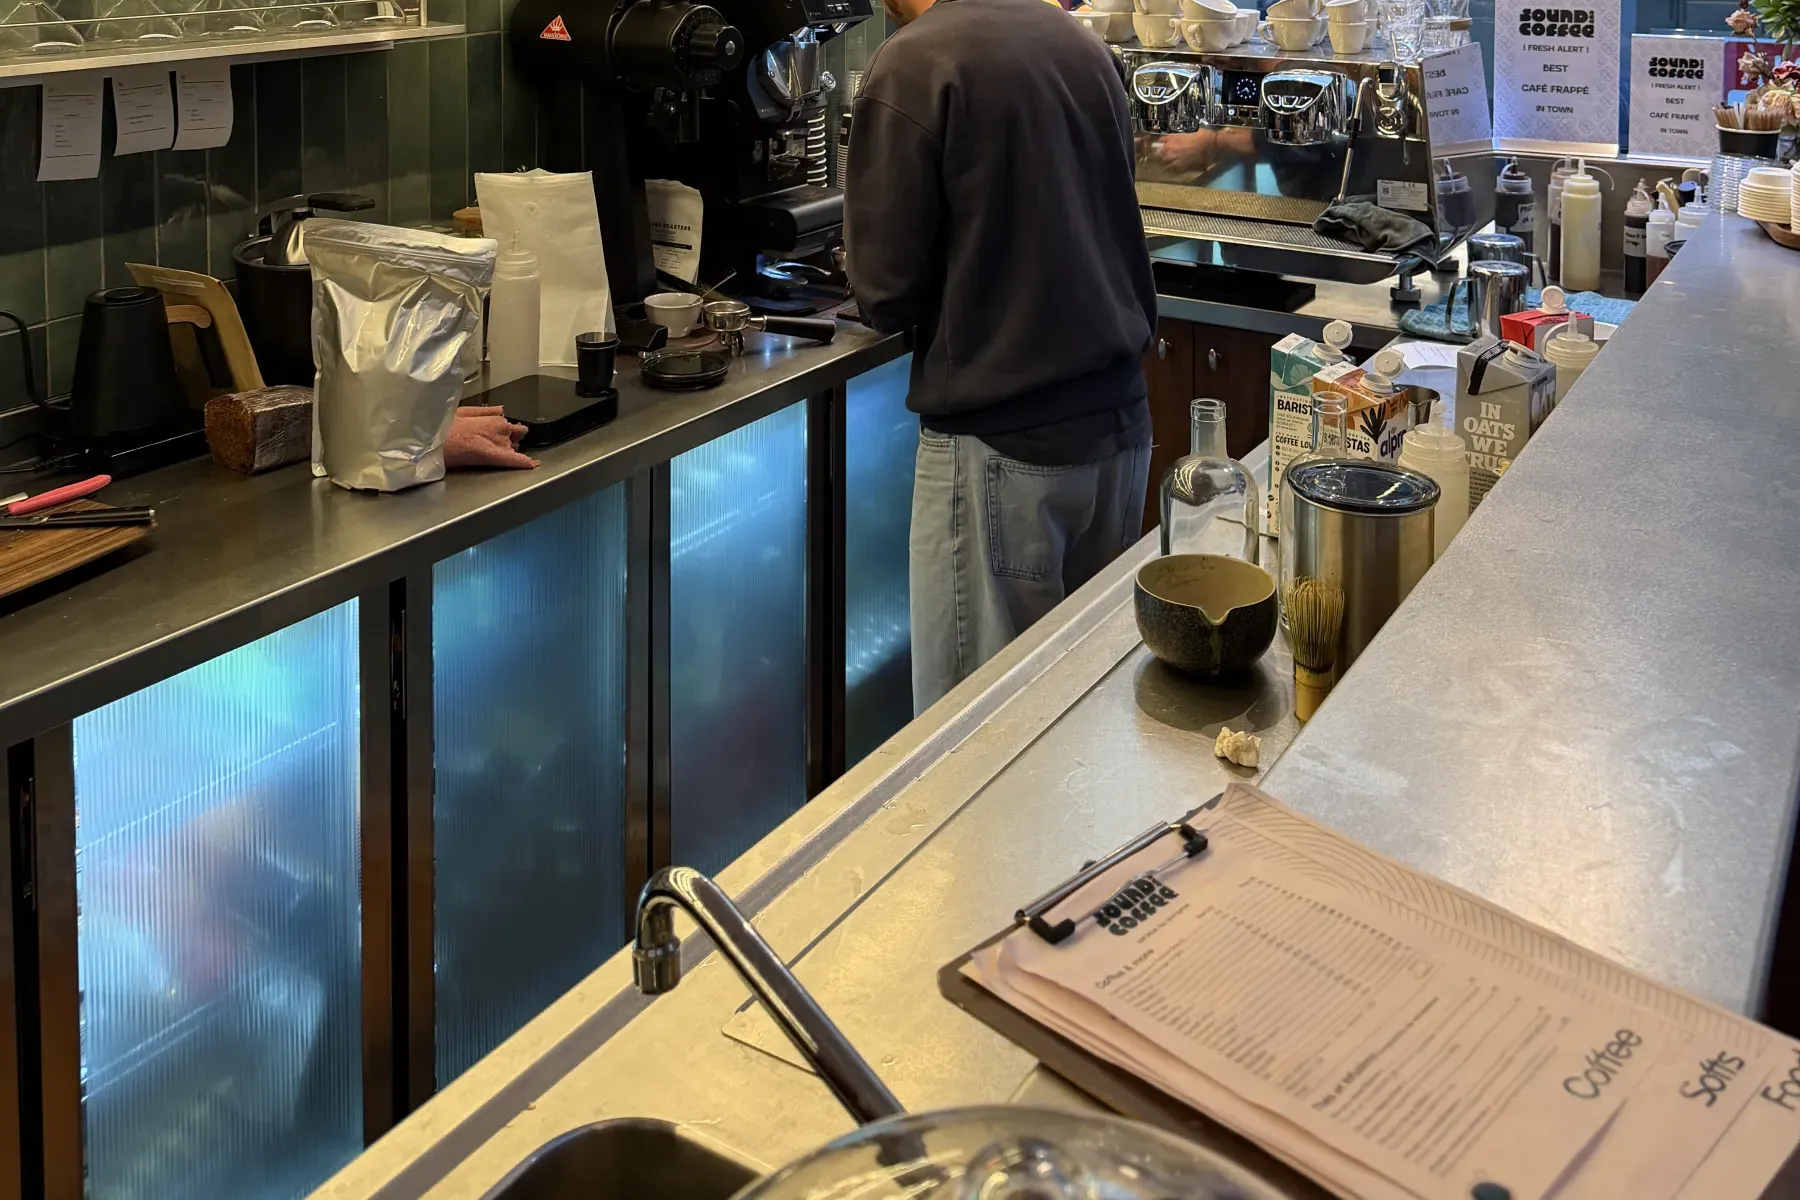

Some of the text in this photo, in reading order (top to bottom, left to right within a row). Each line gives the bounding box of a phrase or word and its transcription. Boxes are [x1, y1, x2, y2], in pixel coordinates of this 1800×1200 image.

[1519, 8, 1589, 24] SOUND
[1519, 22, 1595, 38] COFFEE
[1527, 44, 1555, 52] FRESH
[1557, 45, 1584, 53] ALERT
[1543, 64, 1569, 73] BEST
[1649, 56, 1700, 69] SOUND
[1648, 67, 1704, 80] COFFEE
[1521, 84, 1589, 95] CAFÉ FRAPPÉ
[1547, 105, 1574, 114] TOWN
[1649, 111, 1700, 121] CAFÉ FRAPPÉ
[1479, 401, 1503, 421] IN
[1463, 416, 1516, 442] OATS
[1275, 435, 1299, 447] COFFEE
[1471, 434, 1508, 458] WE
[1108, 885, 1180, 937] COFFEE
[1562, 1028, 1643, 1100] Coffee
[1678, 1050, 1746, 1109] Softs
